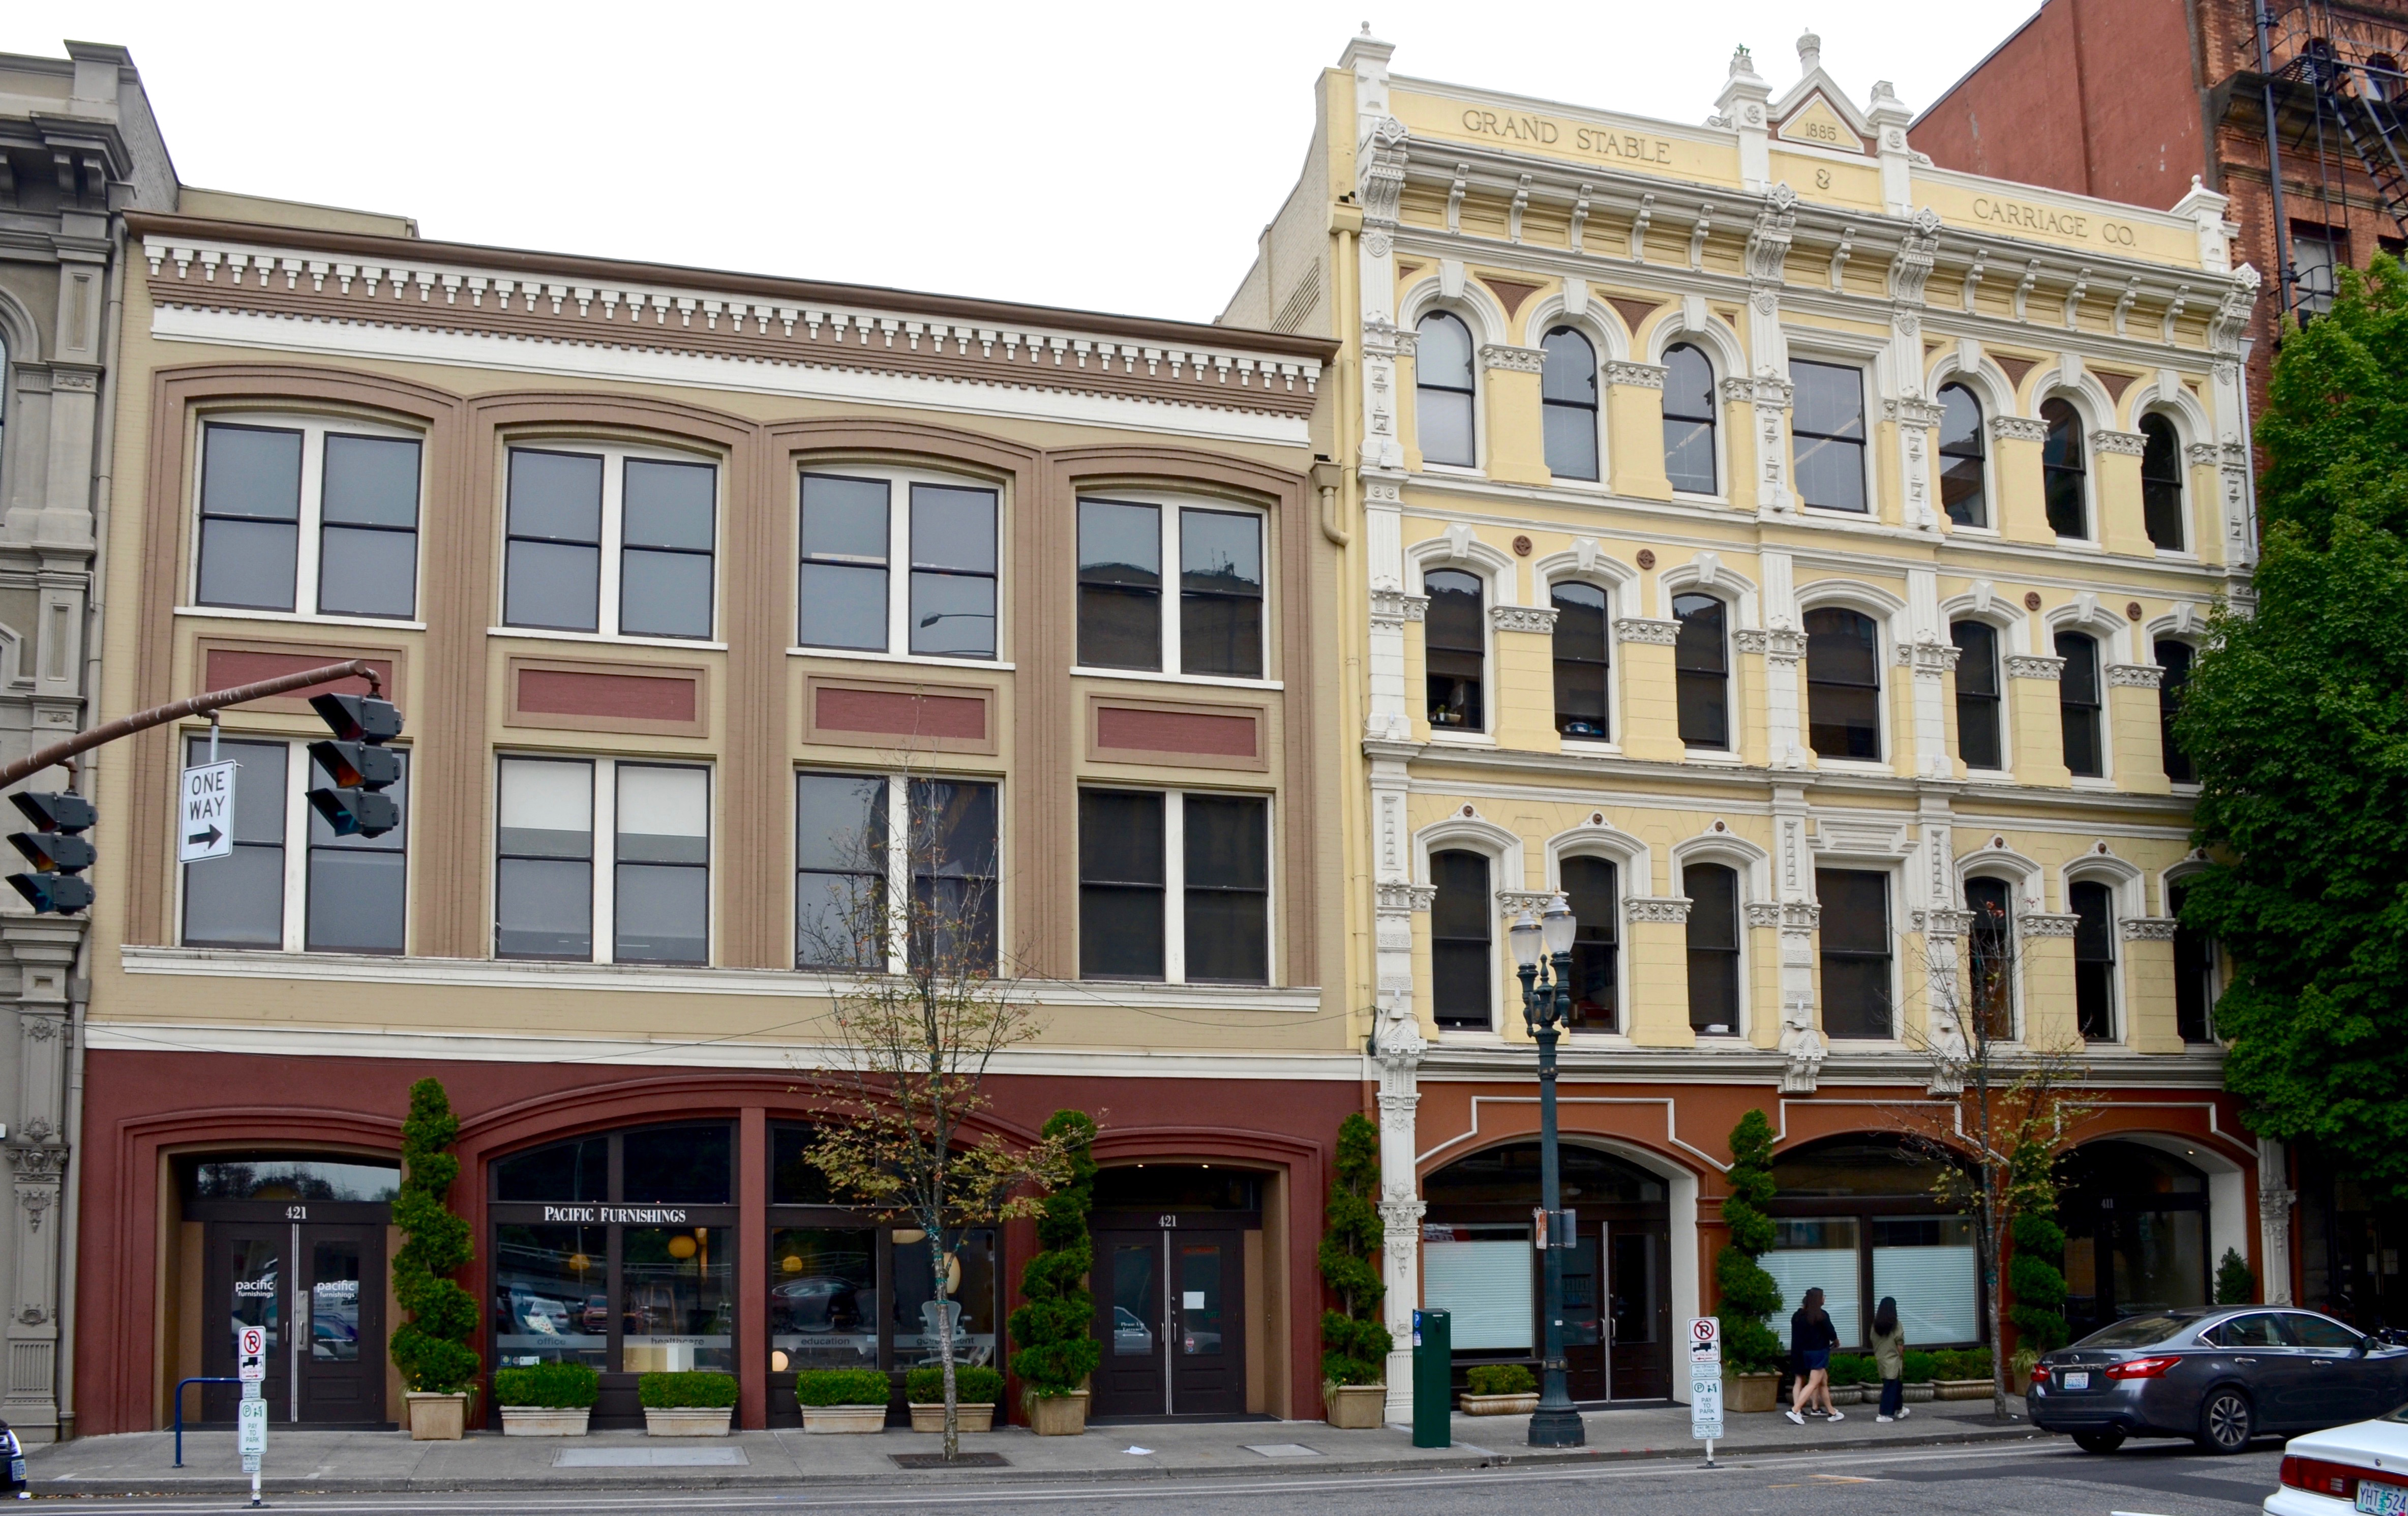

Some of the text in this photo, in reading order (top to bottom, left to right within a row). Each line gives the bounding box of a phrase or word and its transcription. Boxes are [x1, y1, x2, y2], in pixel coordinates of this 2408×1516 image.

[1462, 109, 1671, 164] GRAND STABLE
[1806, 123, 1836, 141] 1885
[1816, 169, 1830, 189] &
[1973, 198, 2136, 247] CARRIAGE CO.
[192, 771, 225, 795] ONE
[190, 795, 225, 820] WAY
[2101, 1198, 2113, 1208] 411
[285, 1206, 307, 1219] 421
[545, 1206, 686, 1223] PACIFIC FURNISHINGS
[1159, 1215, 1177, 1227] 421
[235, 1280, 274, 1292] pacific
[317, 1280, 355, 1293] pacific
[801, 1337, 850, 1345] education
[916, 1337, 974, 1346] govement
[2374, 1483, 2393, 1492] Oregon
[2360, 1487, 2406, 1512] YHT 524
